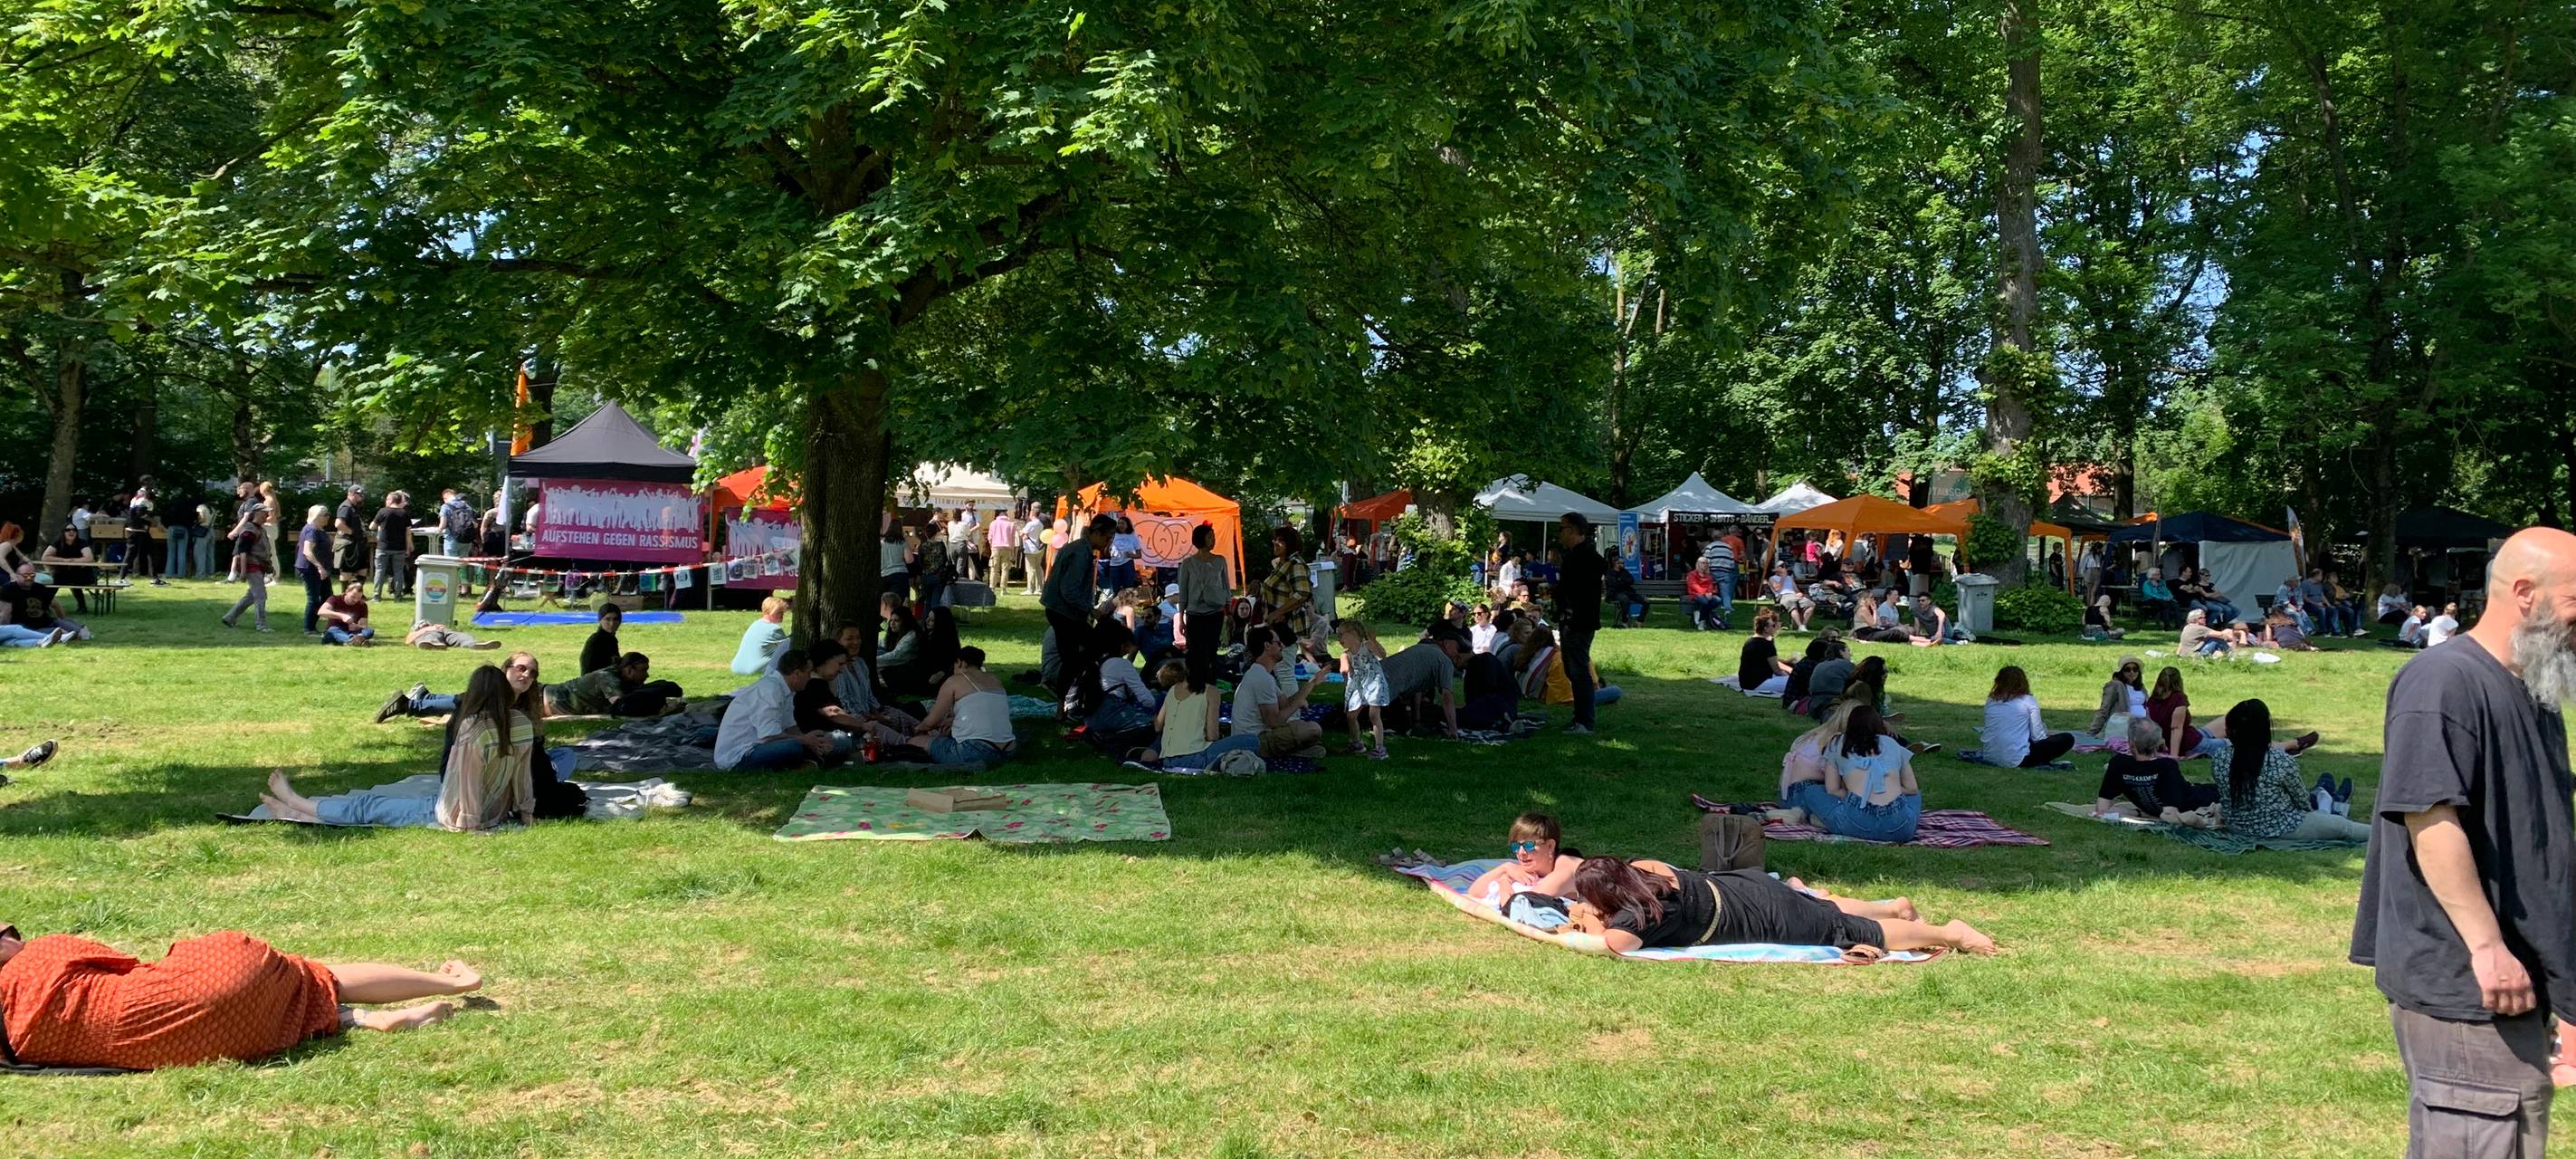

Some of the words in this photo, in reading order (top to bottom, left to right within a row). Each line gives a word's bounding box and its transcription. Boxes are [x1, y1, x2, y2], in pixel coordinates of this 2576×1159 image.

[1673, 512, 1703, 522] STICKER
[1710, 513, 1735, 523] SHIRTS
[541, 529, 599, 545] AUFSTEHEN
[603, 532, 635, 547] GEGEN
[639, 534, 699, 550] RASSISMUS
